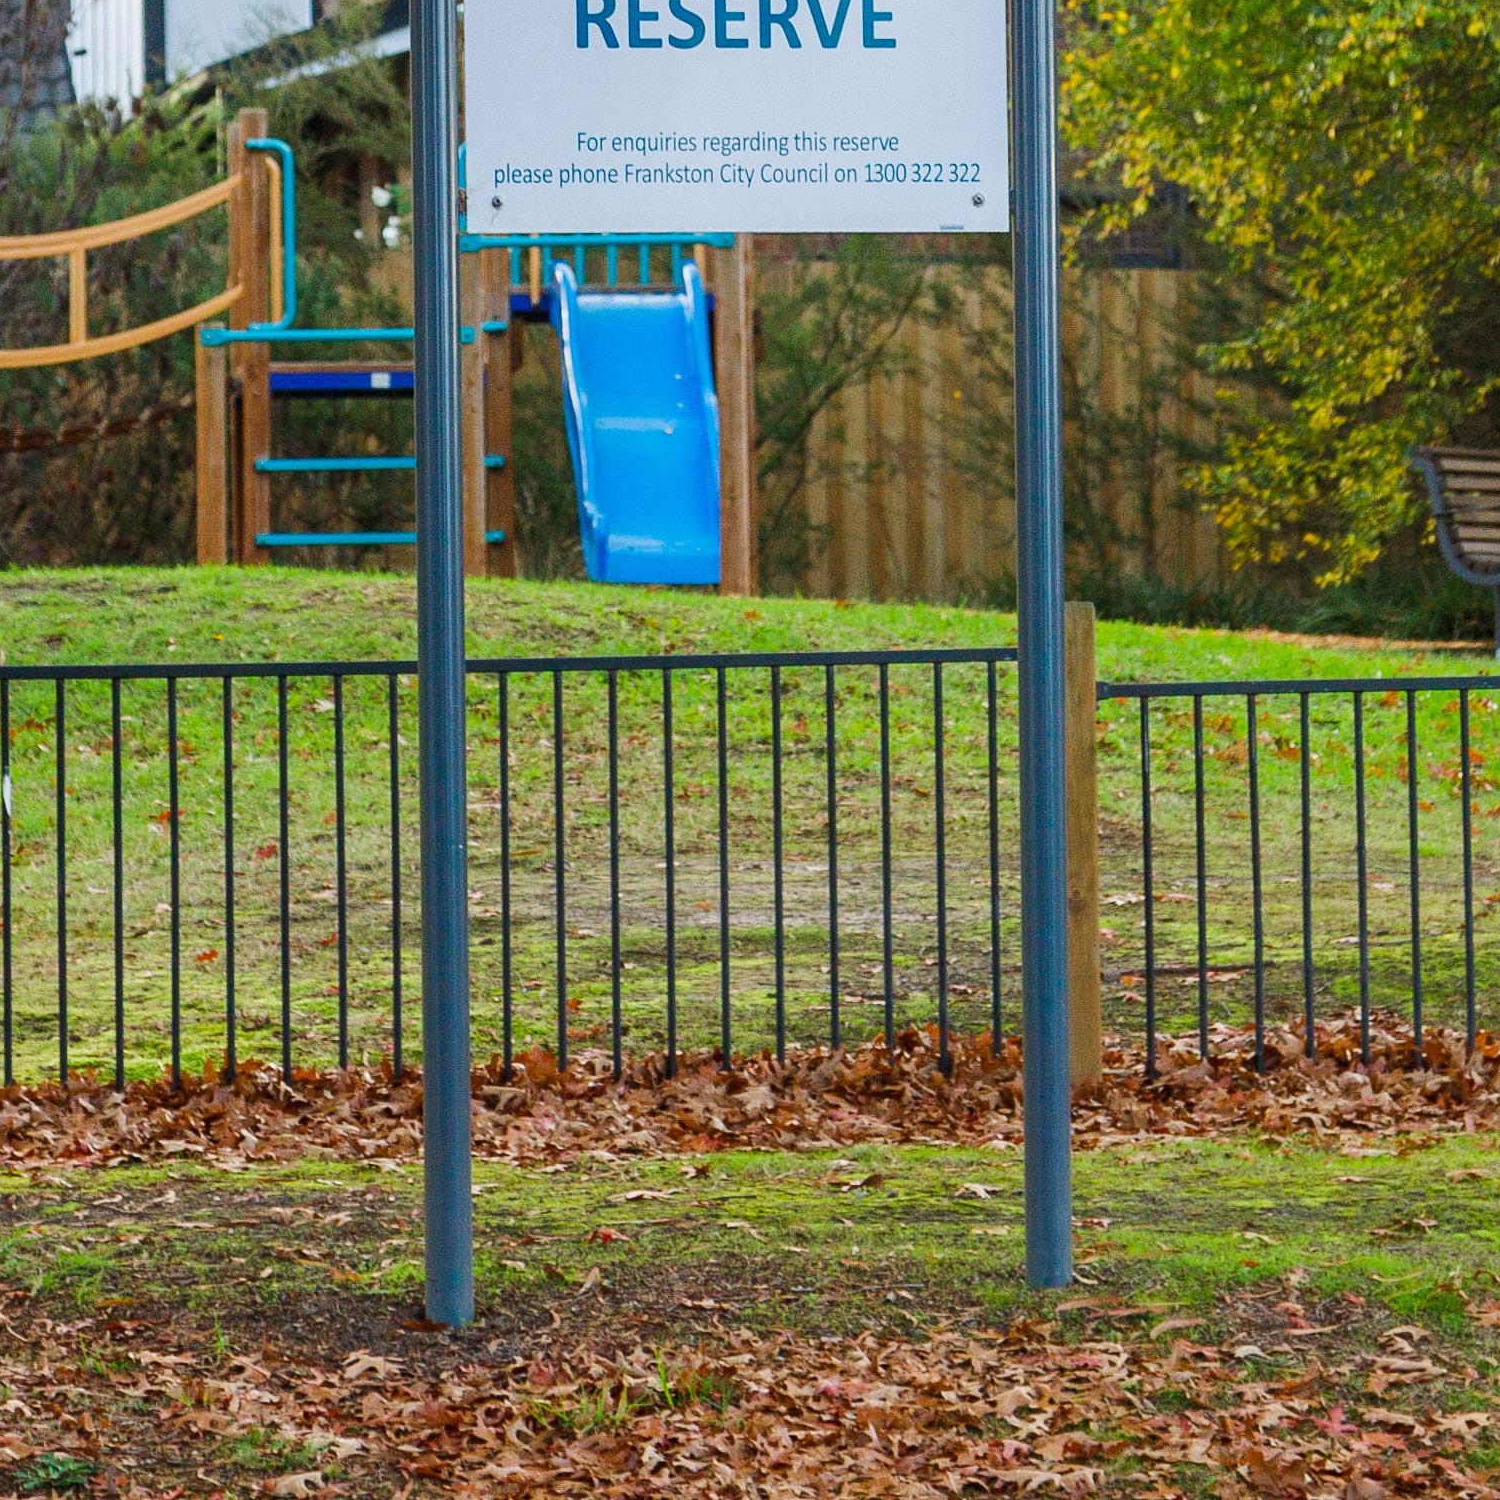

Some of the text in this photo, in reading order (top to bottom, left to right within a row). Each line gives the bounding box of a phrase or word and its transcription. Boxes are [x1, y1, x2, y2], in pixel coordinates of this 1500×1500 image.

[576, 130, 900, 156] For enquiries regarding this reserve
[493, 162, 982, 189] please phone Frankston City Council on 1300 322 322
